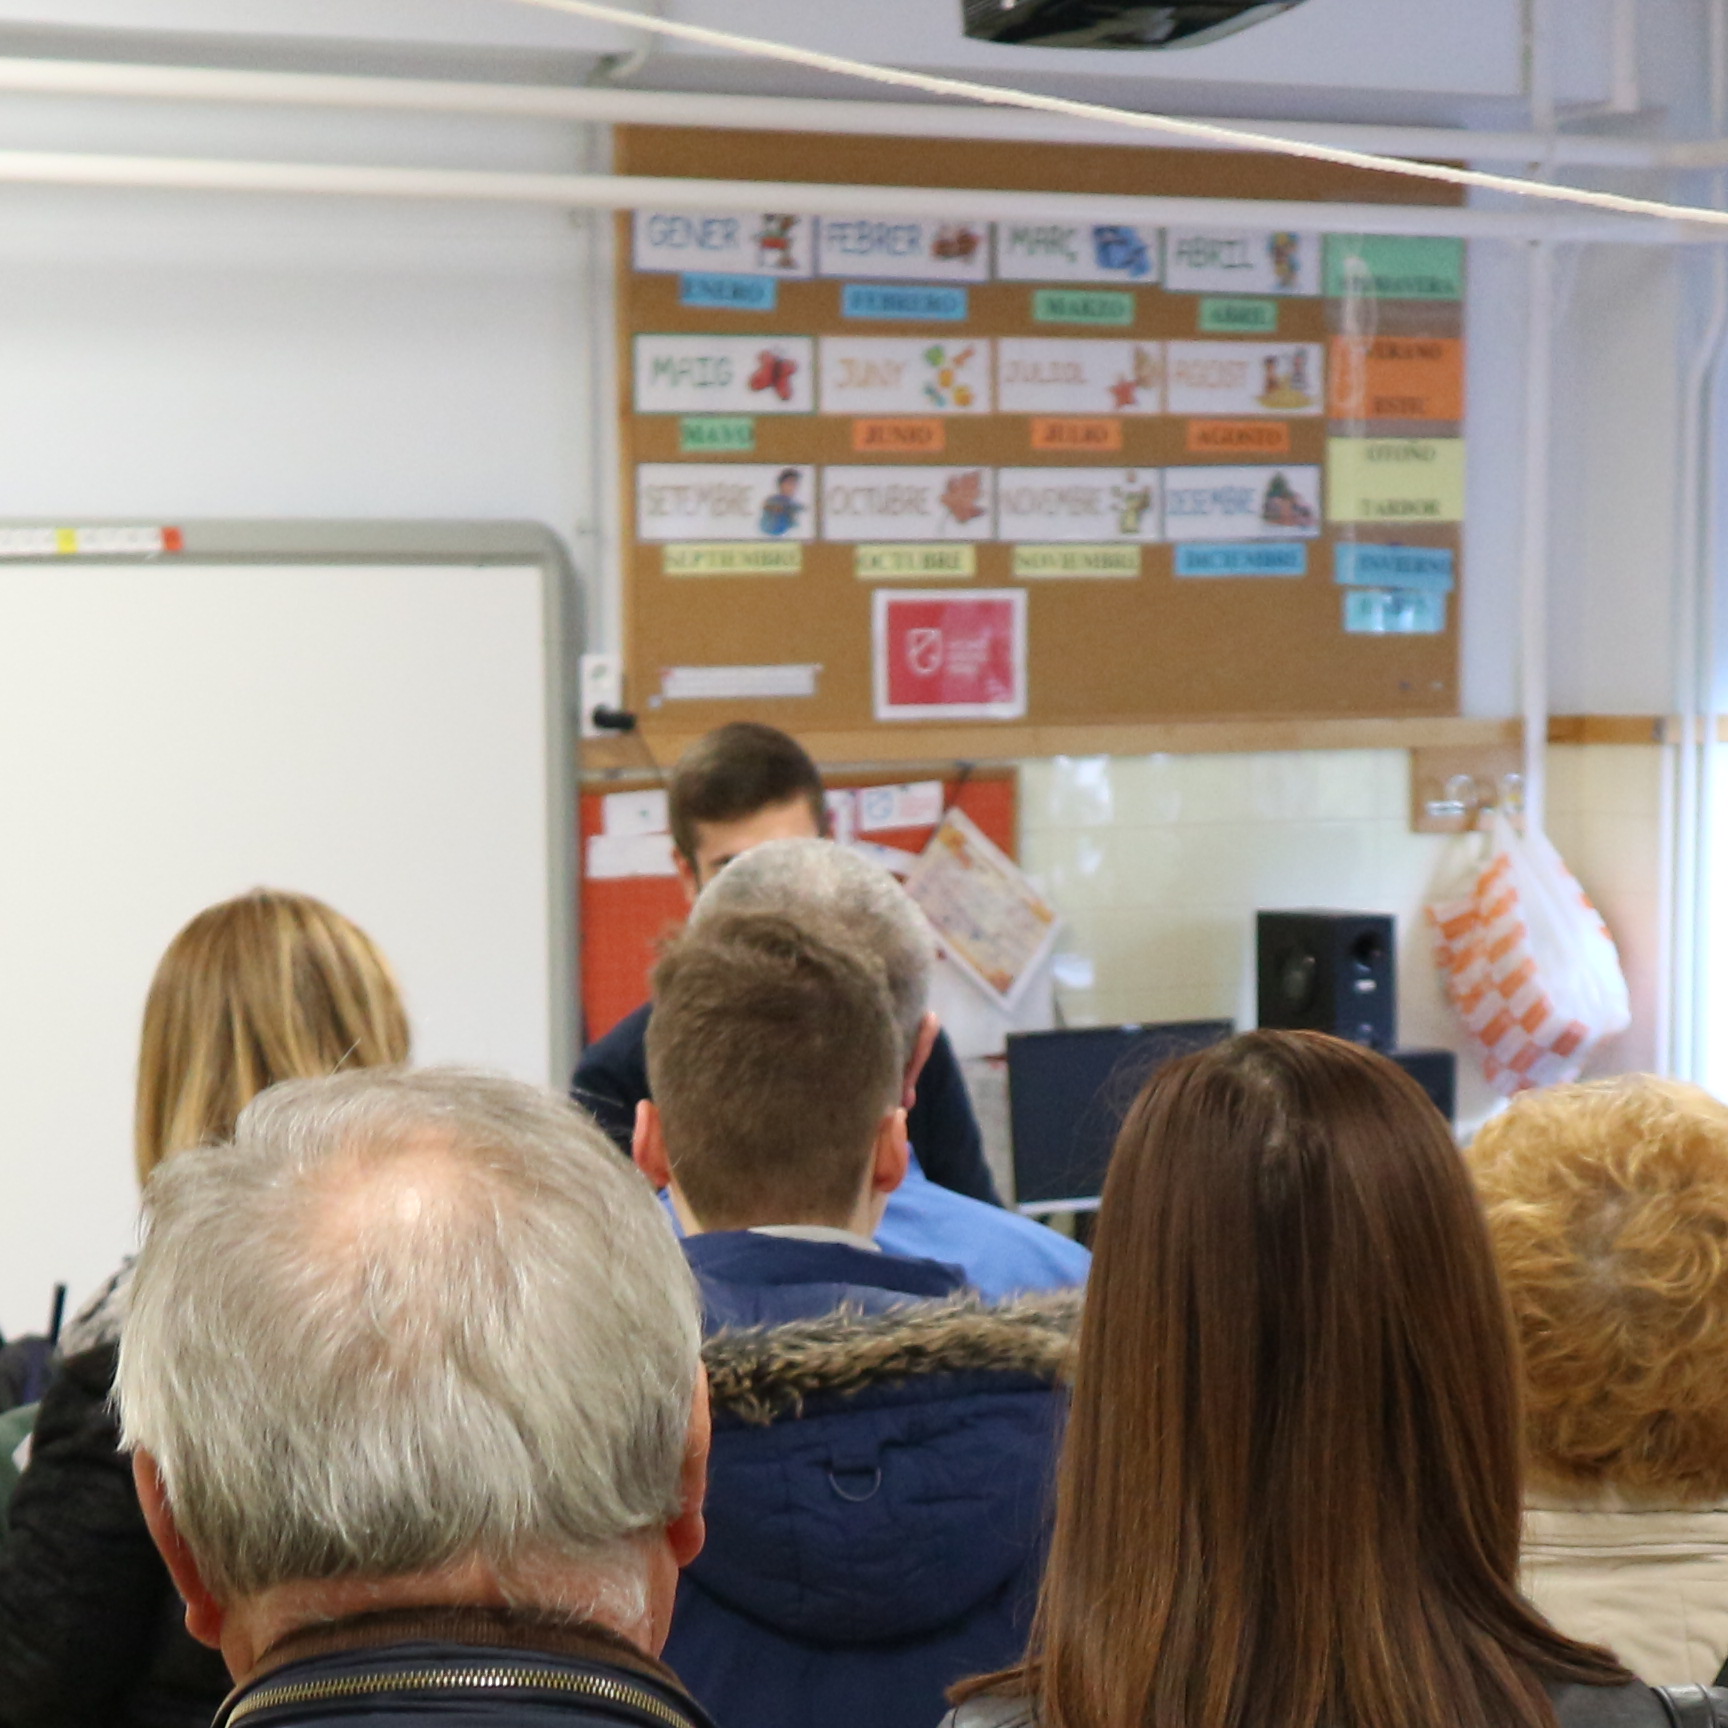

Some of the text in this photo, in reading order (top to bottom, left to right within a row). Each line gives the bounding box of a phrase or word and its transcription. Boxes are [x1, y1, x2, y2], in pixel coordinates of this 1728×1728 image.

[649, 213, 741, 250] GENER
[826, 220, 921, 256] FEBRER
[1176, 236, 1255, 270] ABRIL
[651, 355, 734, 389] MAIG
[864, 422, 934, 446] JUNIO
[1043, 422, 1109, 446] JULIO
[1197, 423, 1282, 446] AGOSTO
[645, 483, 756, 518] SETEMBRE
[827, 484, 931, 517] OCTUBRE
